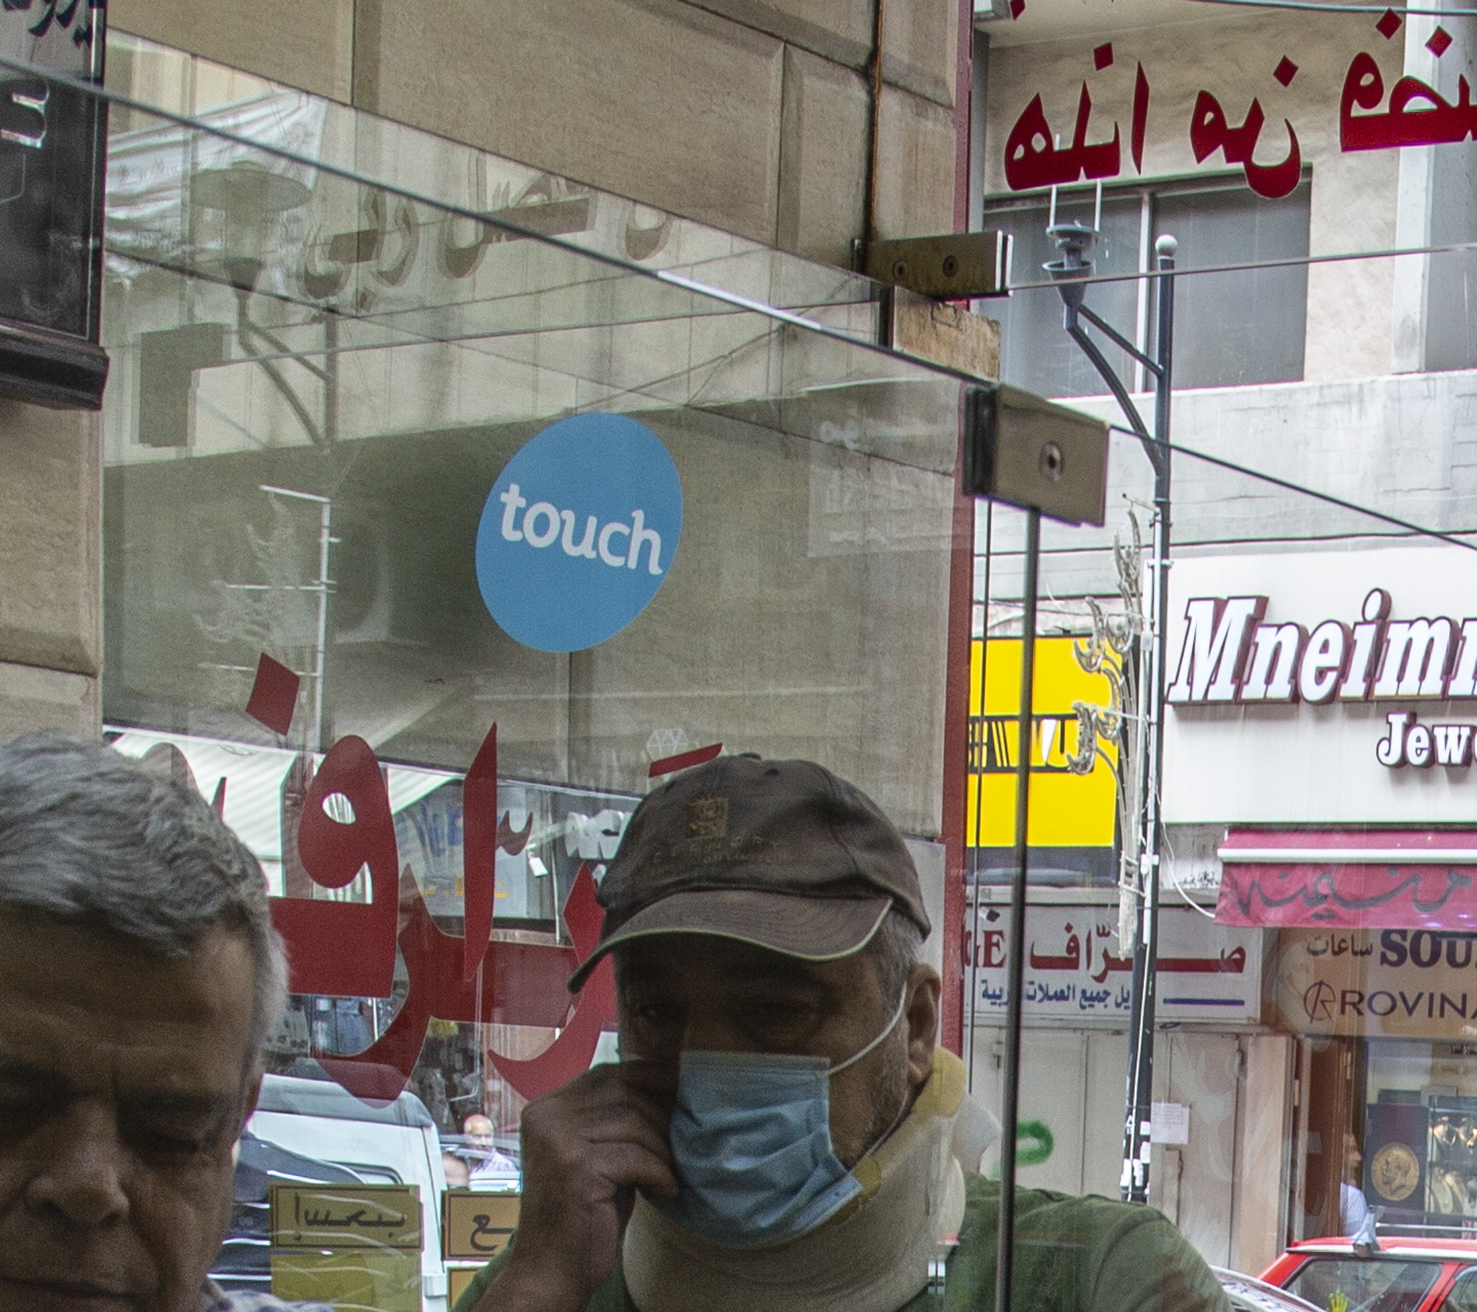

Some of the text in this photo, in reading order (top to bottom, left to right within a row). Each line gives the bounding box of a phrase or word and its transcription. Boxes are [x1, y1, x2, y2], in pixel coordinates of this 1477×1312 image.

[500, 483, 664, 577] touch
[1306, 934, 1374, 960] ساعات
[1079, 985, 1112, 1010] جميع
